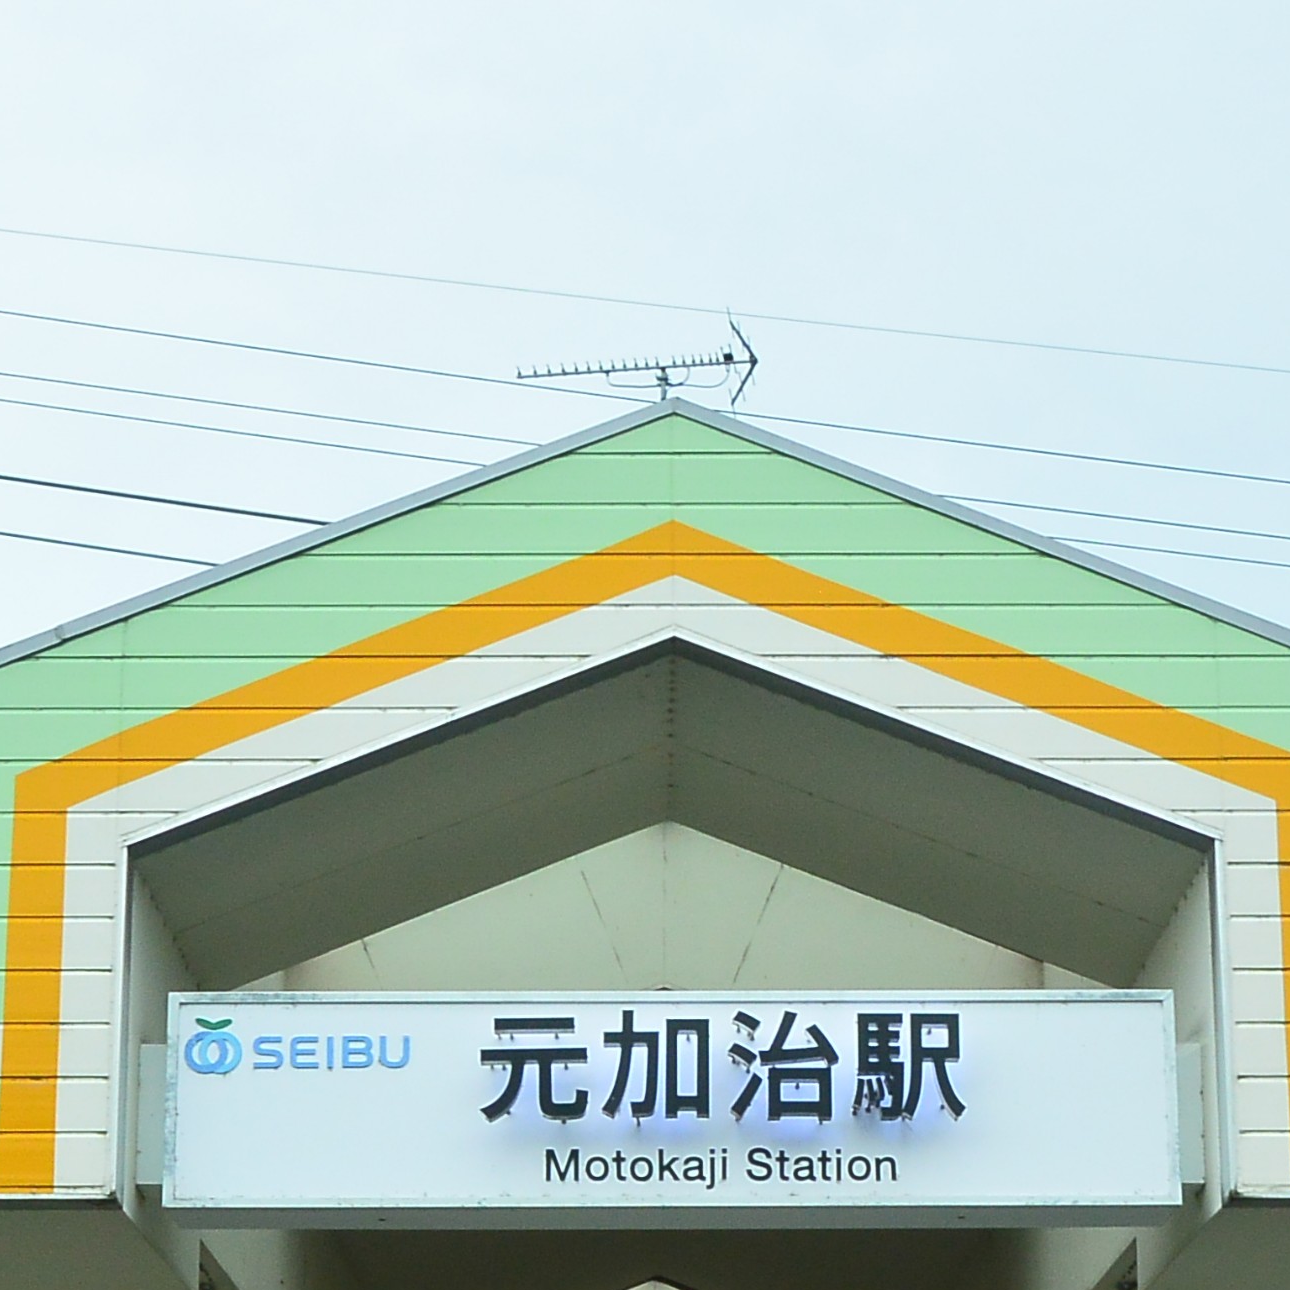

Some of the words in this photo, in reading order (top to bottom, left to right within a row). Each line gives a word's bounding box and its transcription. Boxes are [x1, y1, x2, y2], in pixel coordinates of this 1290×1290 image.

[252, 1035, 411, 1070] SEIBU
[479, 1010, 966, 1124] 元加治駅
[544, 1147, 729, 1189] Motokaji
[745, 1147, 899, 1183] Station
